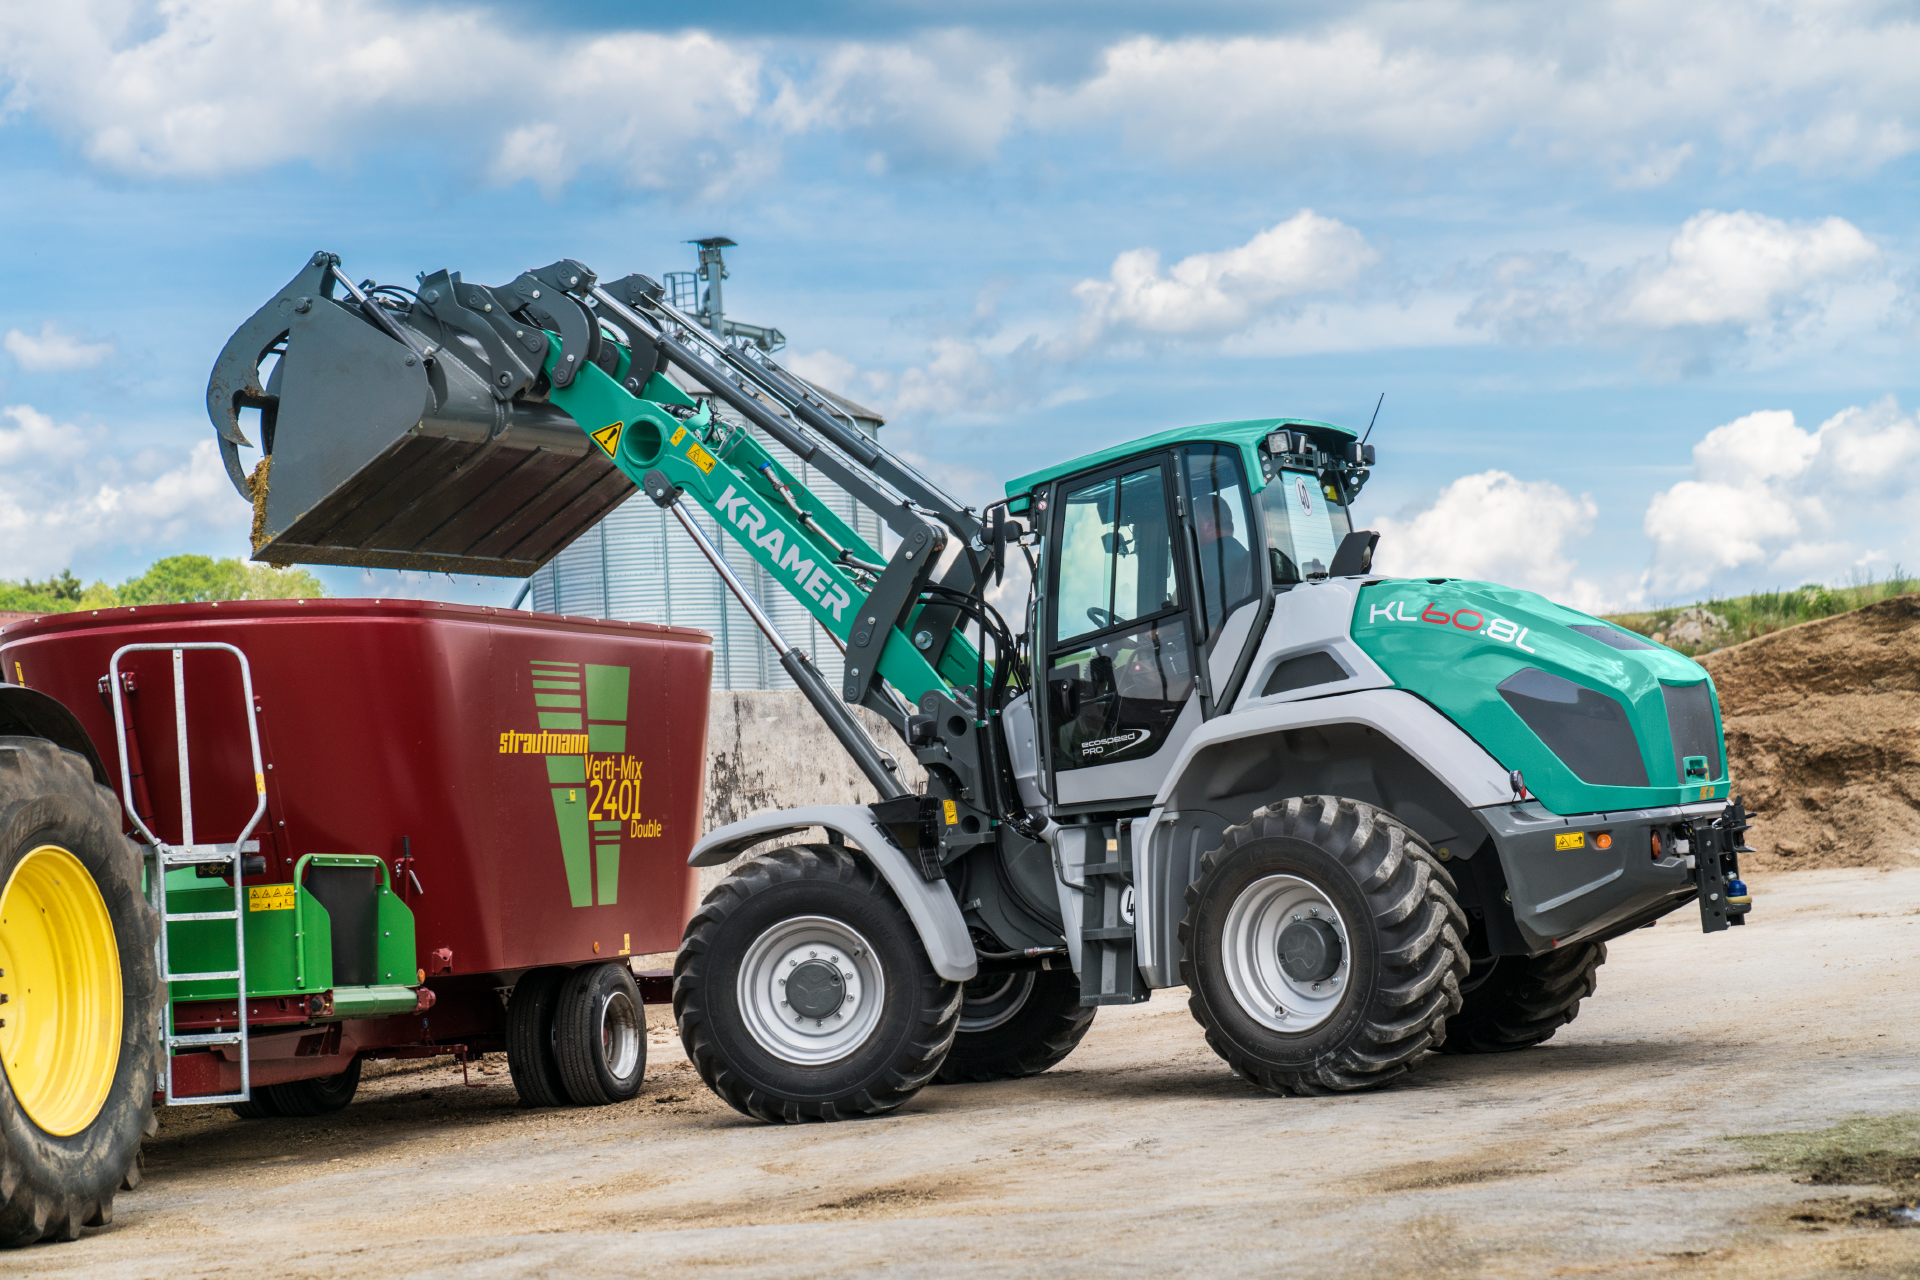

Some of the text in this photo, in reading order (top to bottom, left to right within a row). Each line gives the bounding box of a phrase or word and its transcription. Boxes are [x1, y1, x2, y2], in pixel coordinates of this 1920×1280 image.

[1298, 483, 1310, 510] 40
[714, 484, 850, 622] KRAMER
[499, 730, 589, 753] strautmann
[1081, 732, 1135, 748] ecospeed
[1082, 746, 1104, 756] PRO
[585, 754, 643, 779] Verti-Mix
[588, 779, 641, 821] 2401
[630, 819, 662, 838] Double
